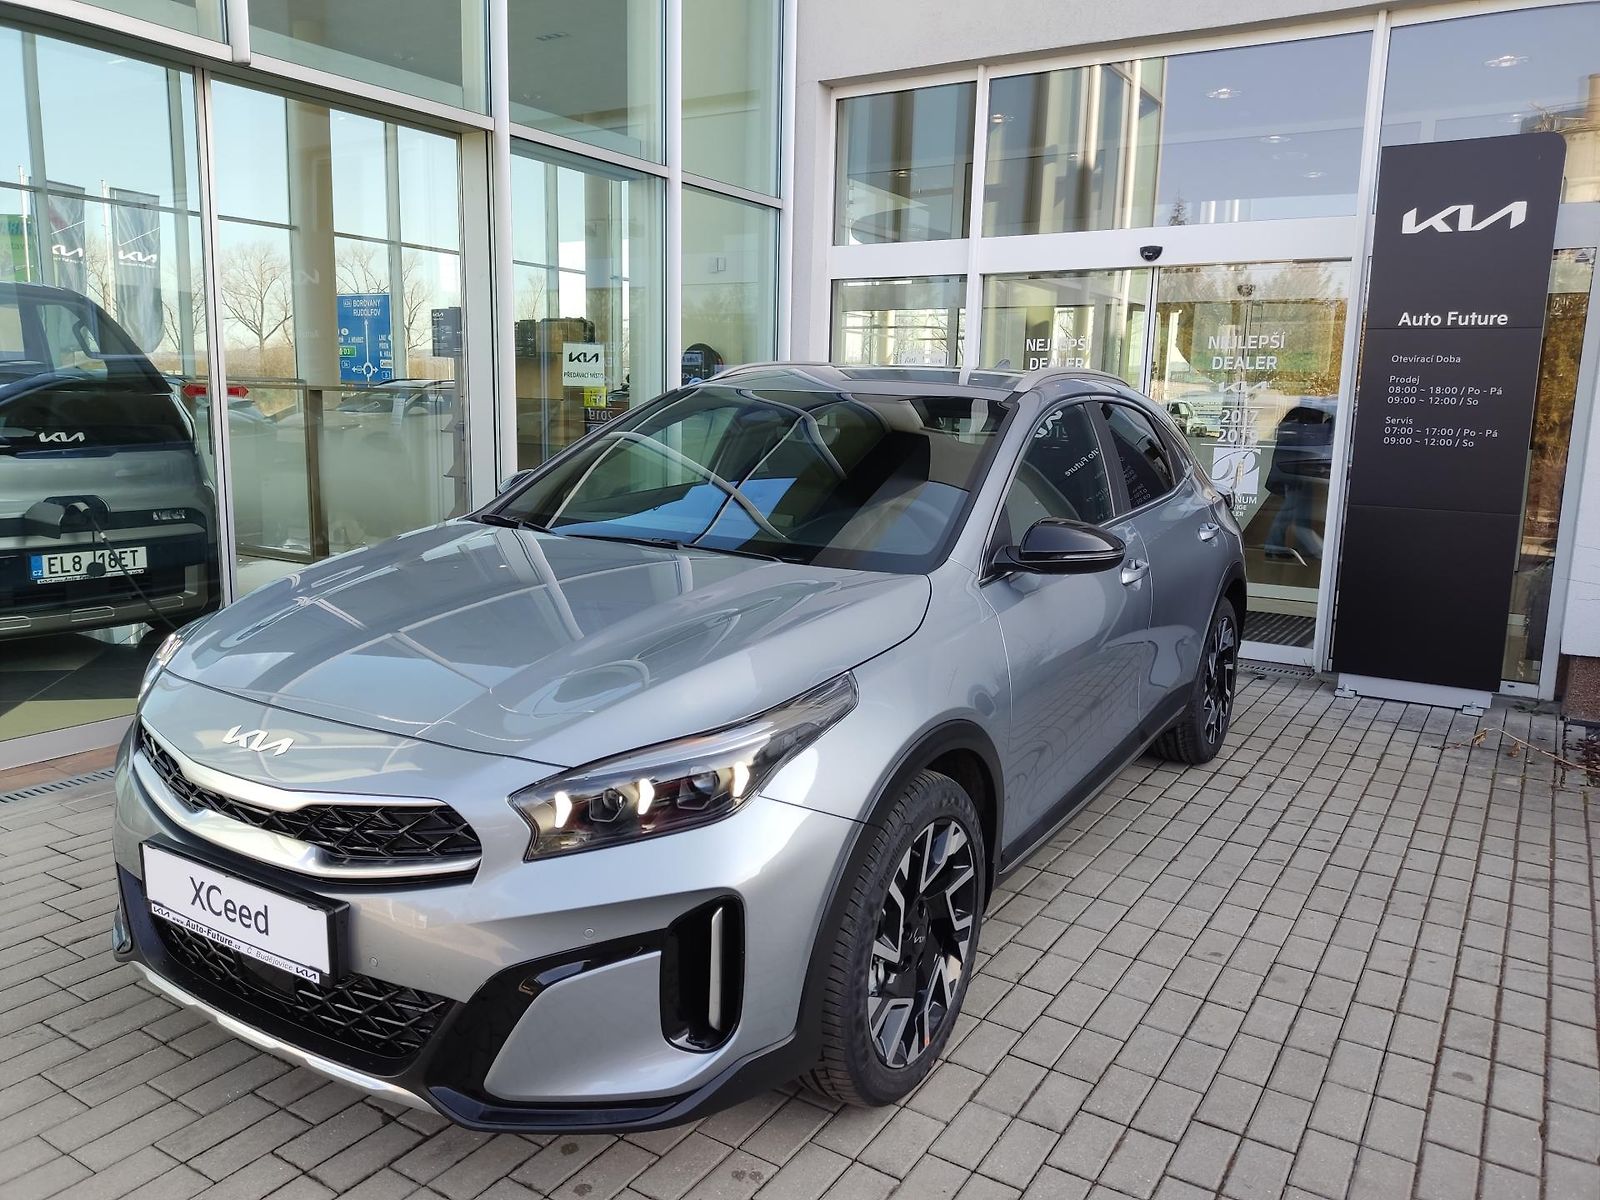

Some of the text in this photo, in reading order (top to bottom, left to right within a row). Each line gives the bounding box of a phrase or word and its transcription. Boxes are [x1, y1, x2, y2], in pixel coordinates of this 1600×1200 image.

[1402, 201, 1527, 234] KIA
[119, 250, 157, 263] KIA
[1398, 311, 1508, 326] Auto Future
[1208, 331, 1286, 349] NEJLEPŠÍ
[569, 352, 599, 363] KIA
[1211, 356, 1277, 370] DEALER
[1391, 354, 1461, 363] Otevírací Doba
[1389, 375, 1420, 385] Prodej
[1388, 386, 1417, 395] 08:00
[1429, 386, 1458, 395] 18:00
[1467, 386, 1481, 395] Po
[1489, 386, 1503, 395] Pá
[1387, 396, 1417, 405] 09:00
[1428, 396, 1457, 405] 12:00
[1466, 397, 1479, 406] So
[1222, 409, 1259, 423] 2017
[1385, 416, 1413, 425] Servis
[38, 431, 85, 443] KIA
[1217, 429, 1258, 443] 2019
[1384, 426, 1413, 435] 07:00
[1424, 427, 1454, 436] 17:00
[1463, 428, 1476, 437] Po
[1485, 428, 1498, 438] Pá
[1383, 437, 1412, 446] 09:00
[1424, 437, 1453, 447] 12:00
[1462, 438, 1475, 448] So
[222, 724, 295, 757] KIA
[188, 875, 270, 937] XCeed
[153, 906, 170, 919] KIA
[295, 966, 317, 980] KIA
